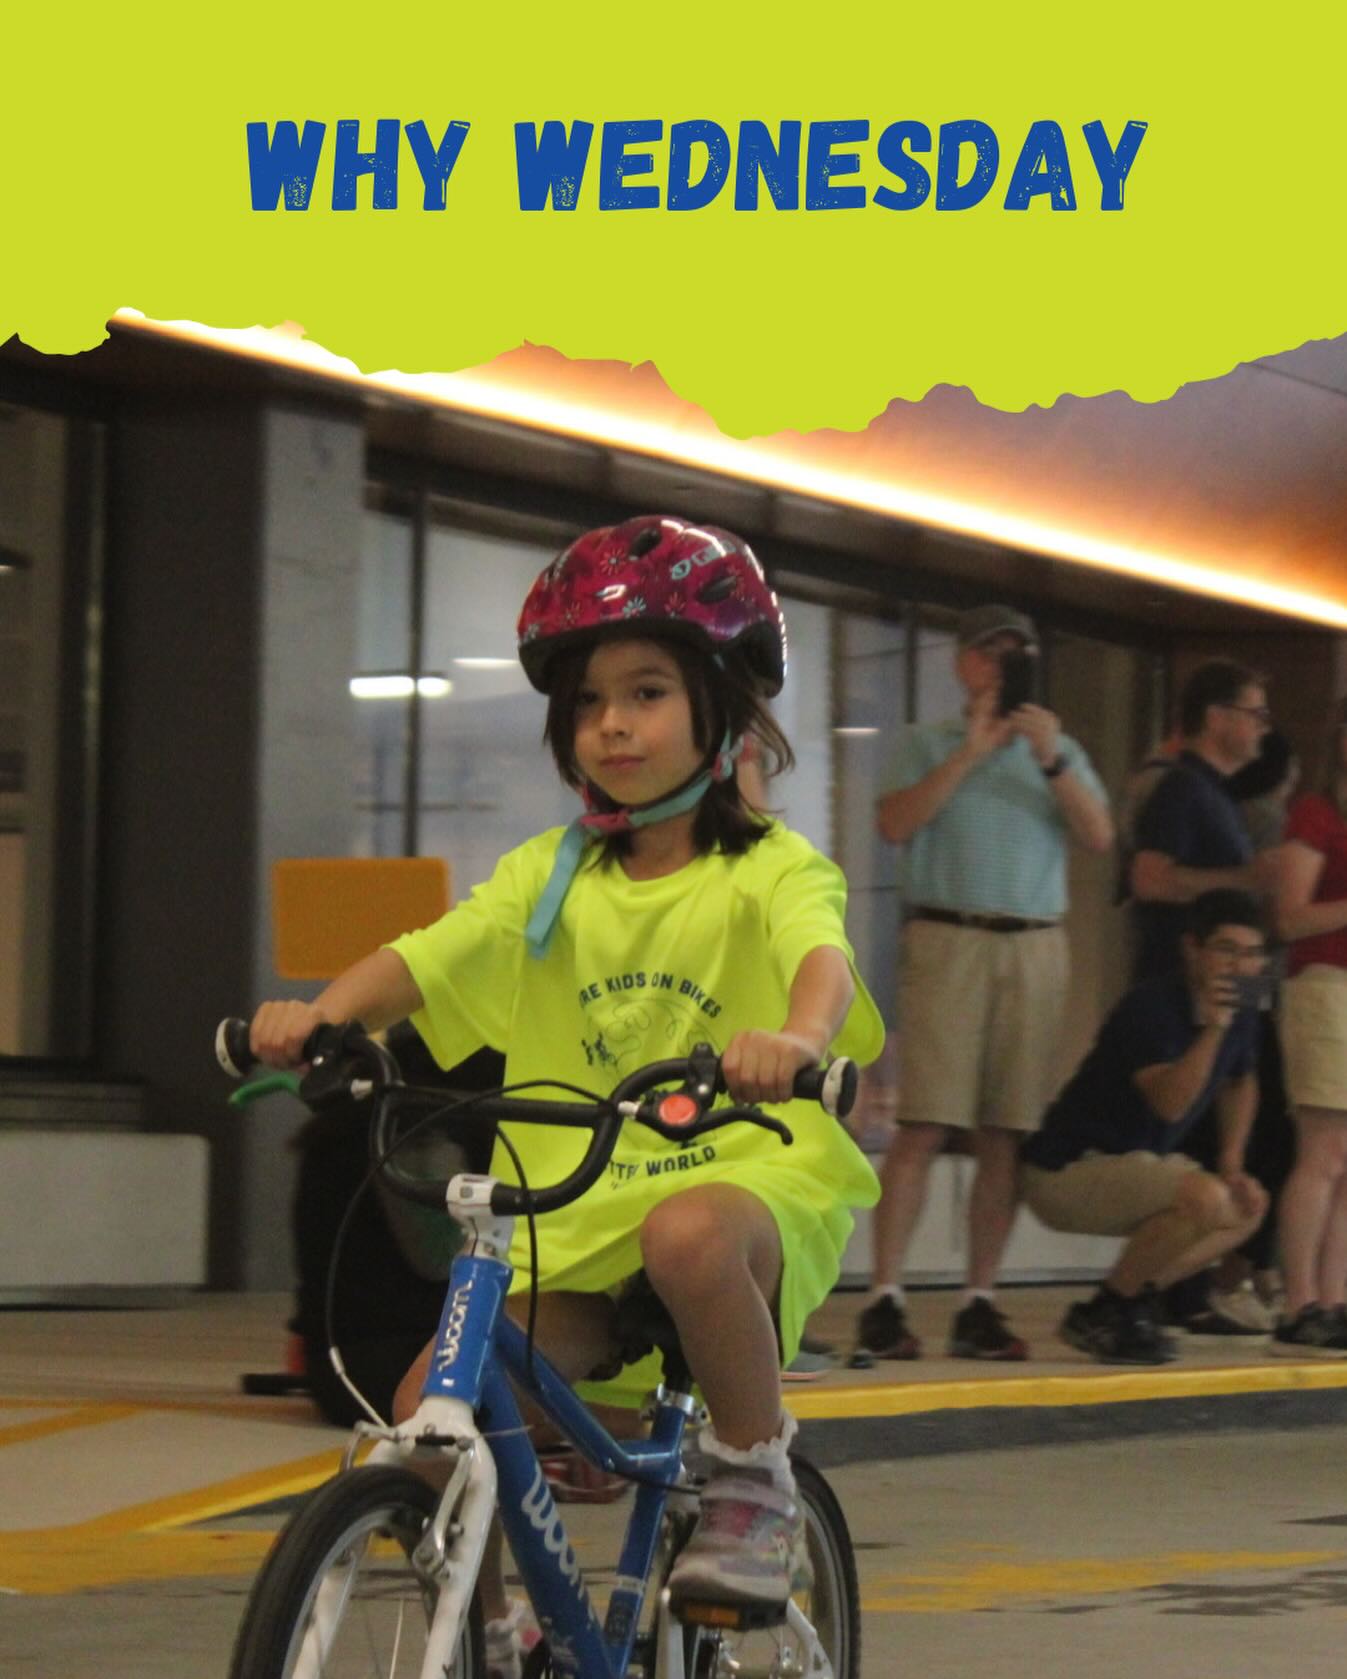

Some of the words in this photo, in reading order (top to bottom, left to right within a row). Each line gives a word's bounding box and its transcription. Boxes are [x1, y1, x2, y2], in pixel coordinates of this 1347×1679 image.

[605, 972, 646, 993] KIDS
[651, 972, 674, 990] ON
[678, 978, 722, 1019] BIKES
[646, 1145, 716, 1177] WORLD
[437, 1279, 473, 1373] woom
